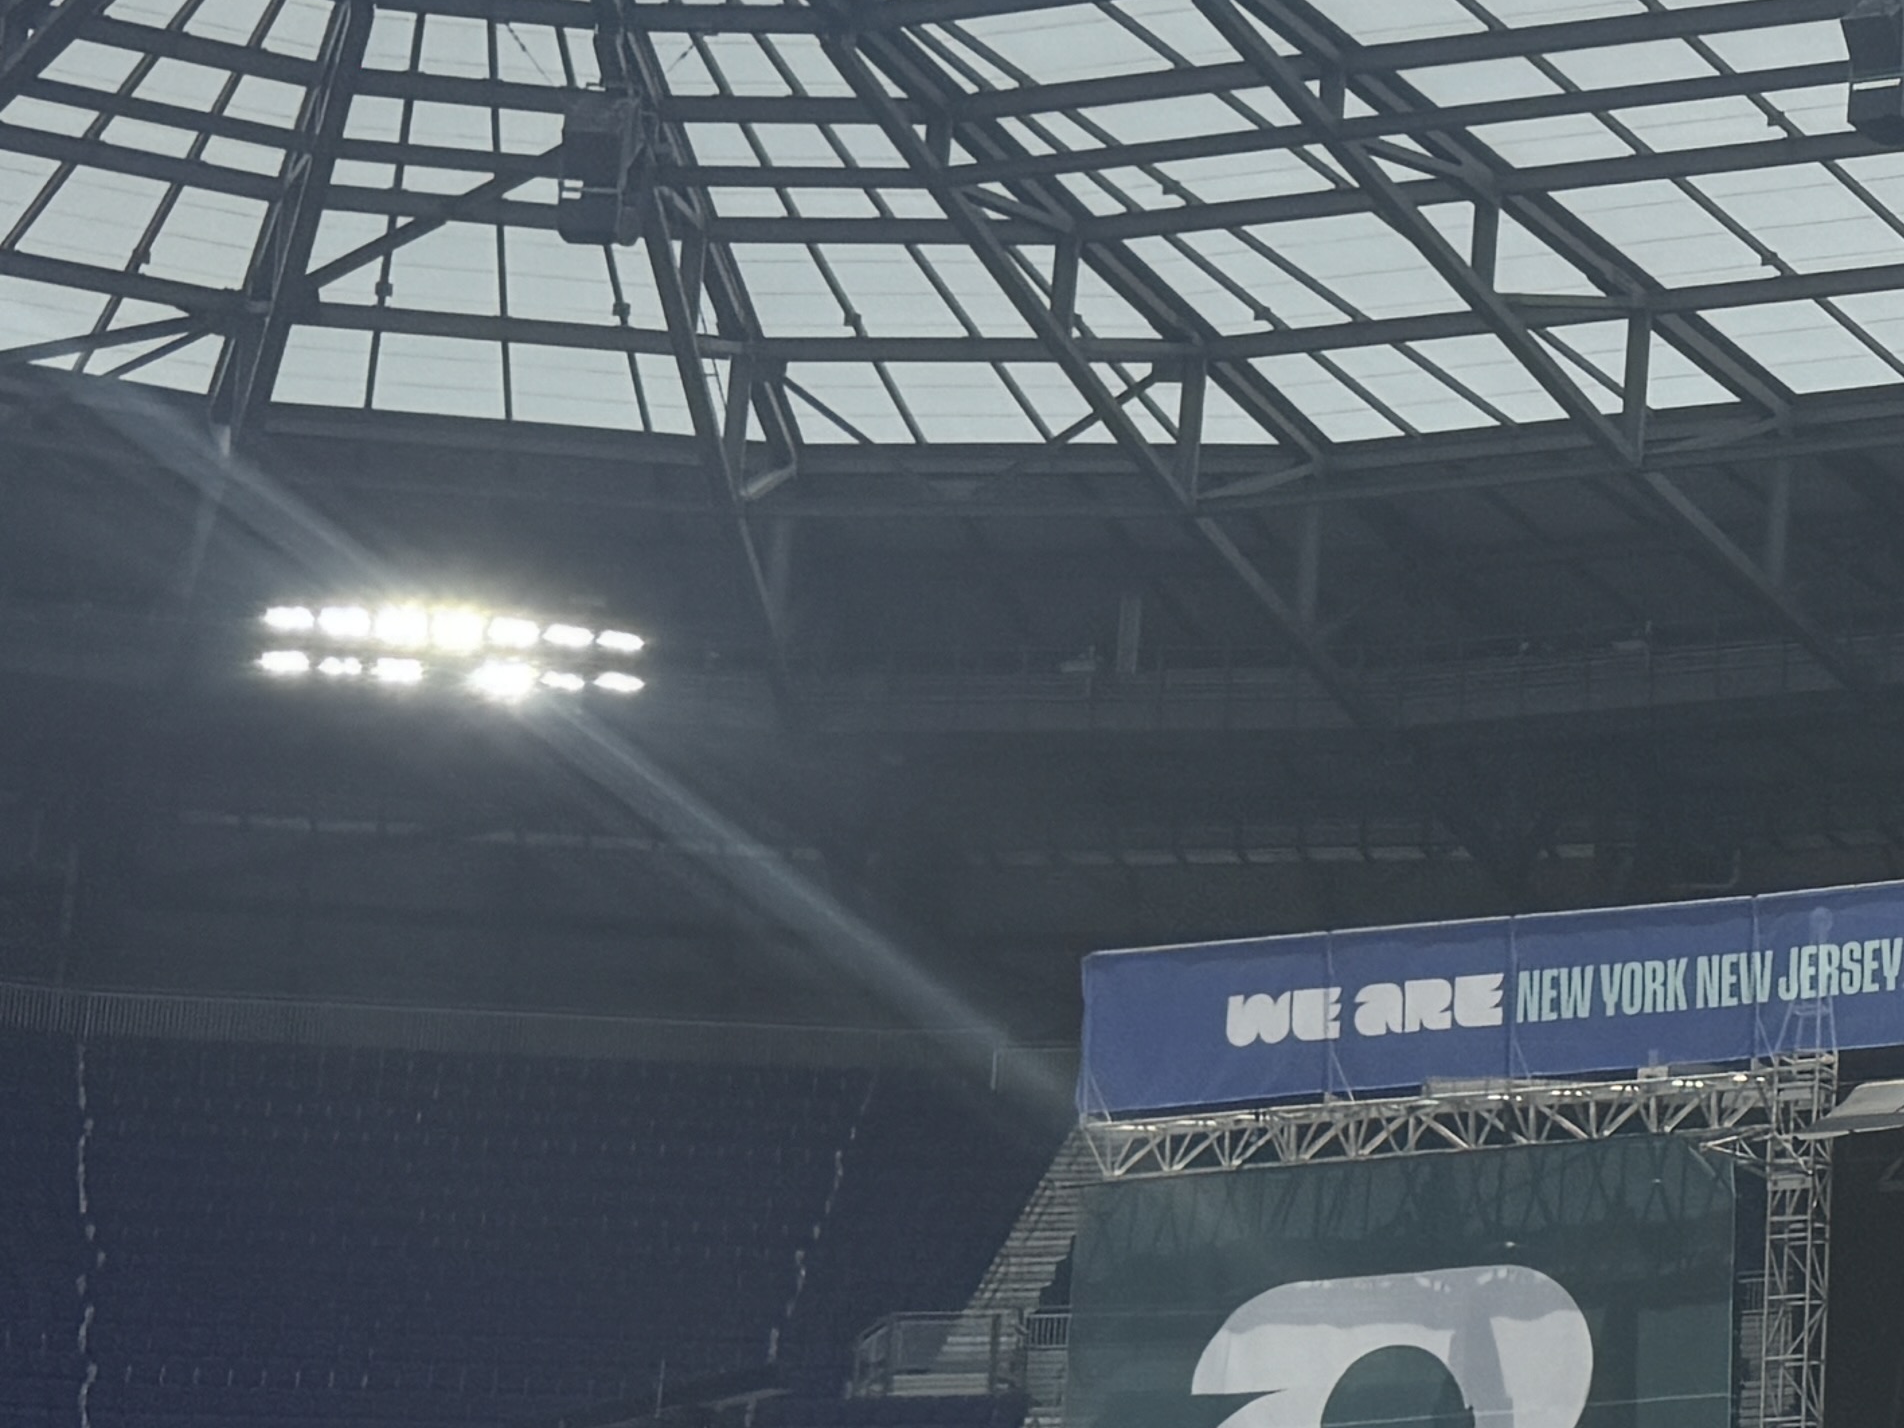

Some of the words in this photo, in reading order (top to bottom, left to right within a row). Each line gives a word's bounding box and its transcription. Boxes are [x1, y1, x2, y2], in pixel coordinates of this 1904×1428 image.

[1225, 986, 1342, 1047] WE
[1515, 964, 1595, 1024] NEW
[1599, 956, 1690, 1017] YORK
[1696, 948, 1774, 1009] NEW
[1777, 936, 1904, 1002] JERSEY
